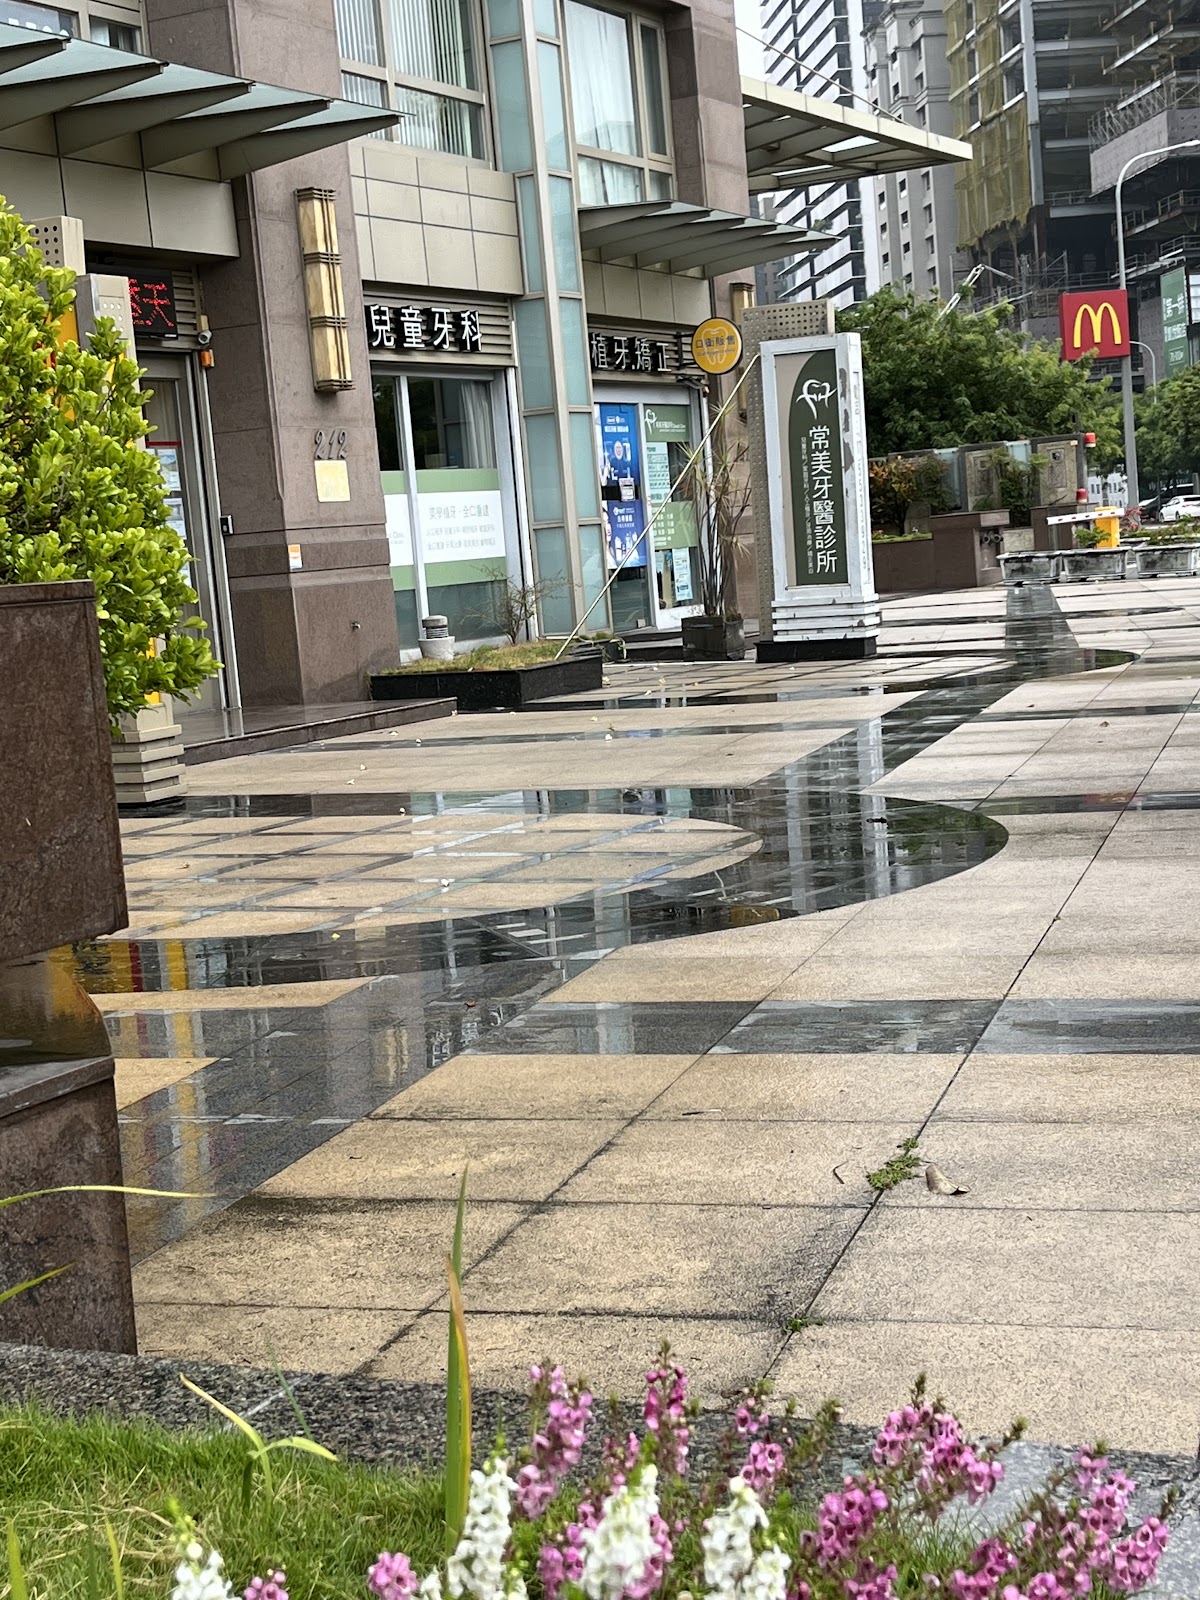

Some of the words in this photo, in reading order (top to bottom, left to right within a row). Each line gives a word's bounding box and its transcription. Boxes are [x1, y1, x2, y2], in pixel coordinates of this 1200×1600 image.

[370, 304, 482, 350] 兒童牙科
[313, 429, 348, 460] 212
[809, 424, 838, 574] 常美牙醫診所
